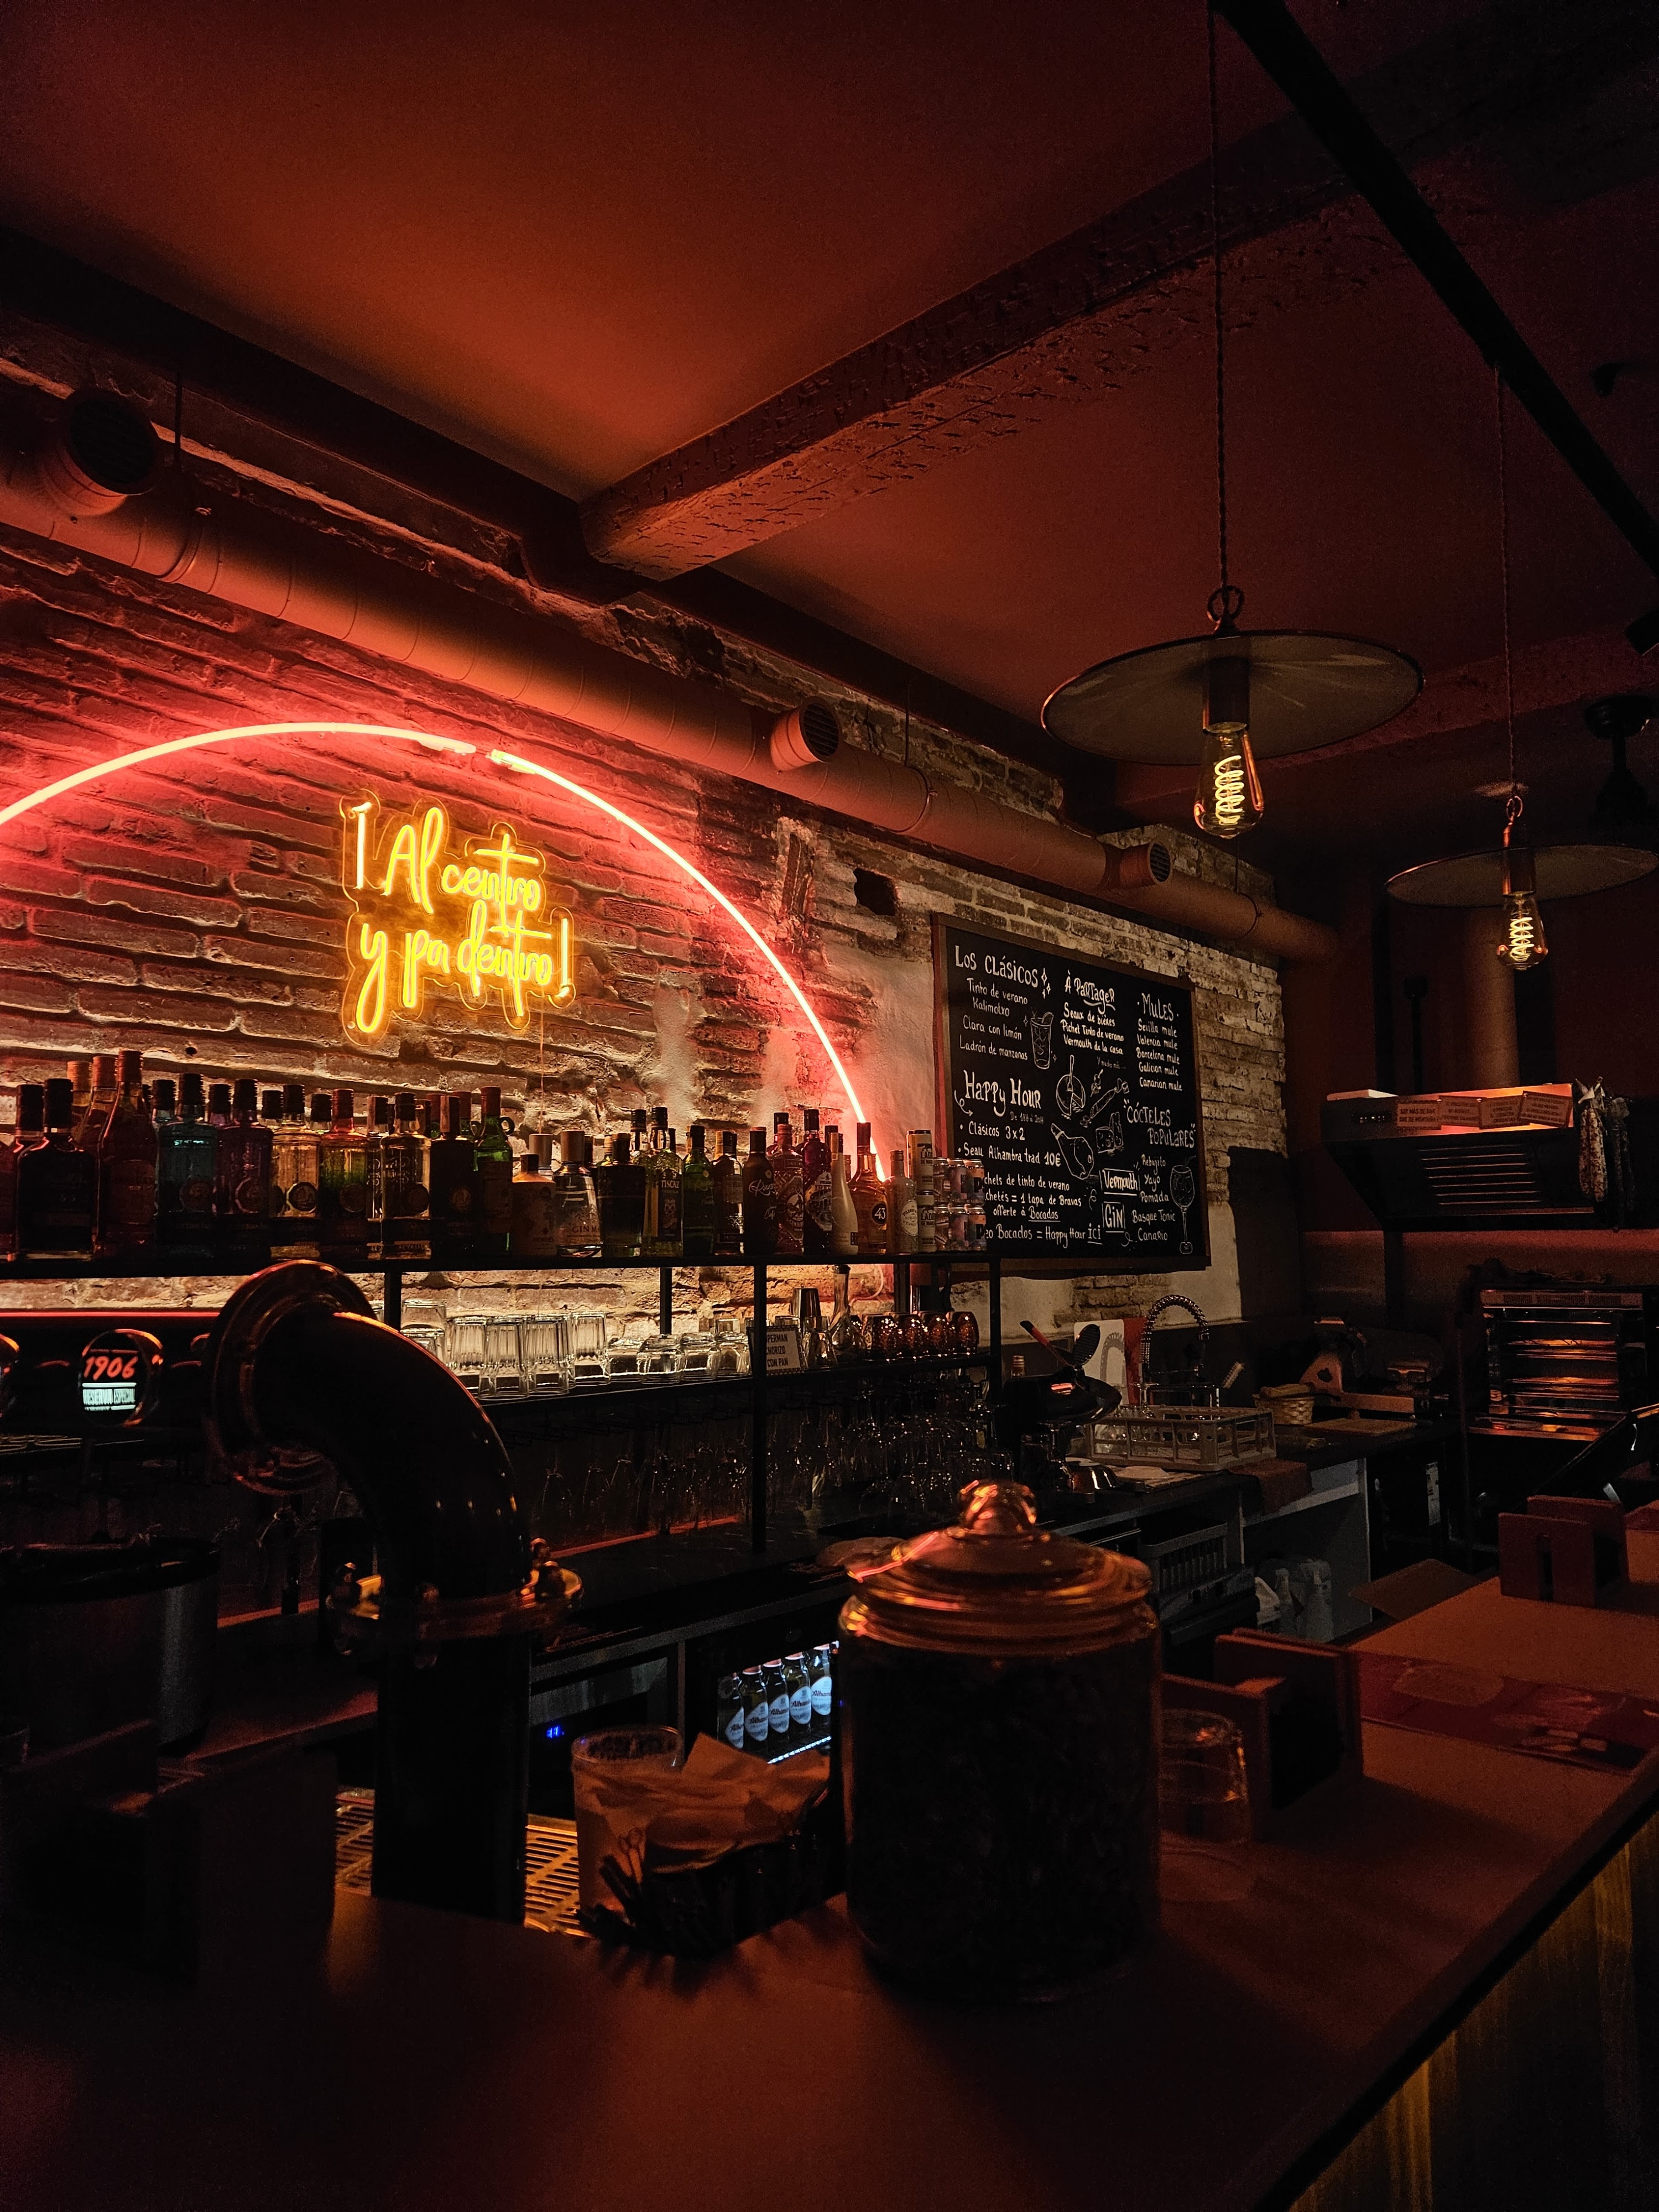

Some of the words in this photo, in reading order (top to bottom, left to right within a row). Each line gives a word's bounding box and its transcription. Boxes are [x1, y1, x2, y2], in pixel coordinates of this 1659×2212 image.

[442, 833, 540, 937] centro
[356, 923, 387, 1033] y
[403, 929, 450, 1008] pa
[967, 978, 988, 995] Tinto
[990, 983, 999, 998] de
[1002, 991, 1027, 1004] verano
[973, 997, 1010, 1016] Kalimotxo
[1063, 1001, 1084, 1019] Seaux
[1087, 1010, 1095, 1022] de
[963, 1015, 985, 1032] Clara
[988, 1025, 1000, 1036] con
[1003, 1024, 1022, 1040] limón
[1060, 1019, 1081, 1034] Pichet
[1082, 1025, 1095, 1036] Tinto
[1097, 1028, 1104, 1039] de
[1105, 1032, 1124, 1041] verano
[1138, 1018, 1159, 1033] Sevilla
[1162, 1025, 1177, 1037] mule
[959, 1035, 986, 1053] Ladrón
[988, 1042, 997, 1055] de
[999, 1048, 1028, 1061] manzanas
[1063, 1034, 1093, 1050] Vermouth
[1094, 1041, 1100, 1051] de
[1102, 1041, 1108, 1052] la
[1110, 1046, 1124, 1055] casa
[1137, 1034, 1161, 1047] Valencia
[1164, 1040, 1178, 1050] mule
[1136, 1047, 1165, 1061] Barcelona
[1167, 1053, 1180, 1065] mule
[1139, 1061, 1162, 1073] Galician
[1165, 1066, 1179, 1076] mule
[1139, 1077, 1167, 1089] Canarian
[1168, 1080, 1182, 1091] mule
[968, 1120, 1000, 1137] Clásicos
[963, 1142, 984, 1157] Seau
[988, 1145, 1022, 1162] Alhambra
[1024, 1147, 1041, 1164] trad
[1044, 1151, 1061, 1167] 10€
[984, 1172, 1003, 1186] chets
[1006, 1173, 1015, 1186] de
[1018, 1173, 1035, 1187] tinto
[1038, 1176, 1046, 1188] de
[1048, 1181, 1070, 1191] verano
[1144, 1173, 1161, 1192] Yayo
[985, 1188, 1009, 1202] chetés
[1028, 1193, 1044, 1207] tapa
[1048, 1194, 1056, 1206] de
[1058, 1194, 1082, 1207] Bravas
[1139, 1190, 1170, 1203] Pomada
[874, 1207, 886, 1219] 43
[993, 1204, 1016, 1217] offerte
[1021, 1206, 1026, 1216] à
[1028, 1206, 1058, 1220] Bocados
[1131, 1209, 1157, 1225] Basque
[1158, 1209, 1176, 1222] Tonic
[995, 1223, 1033, 1240] Bocados
[1045, 1225, 1068, 1249] Happy
[1070, 1227, 1086, 1239] Hour
[767, 1333, 788, 1343] PERMAN
[766, 1345, 786, 1355] HORIZO
[84, 1356, 138, 1381] 1906
